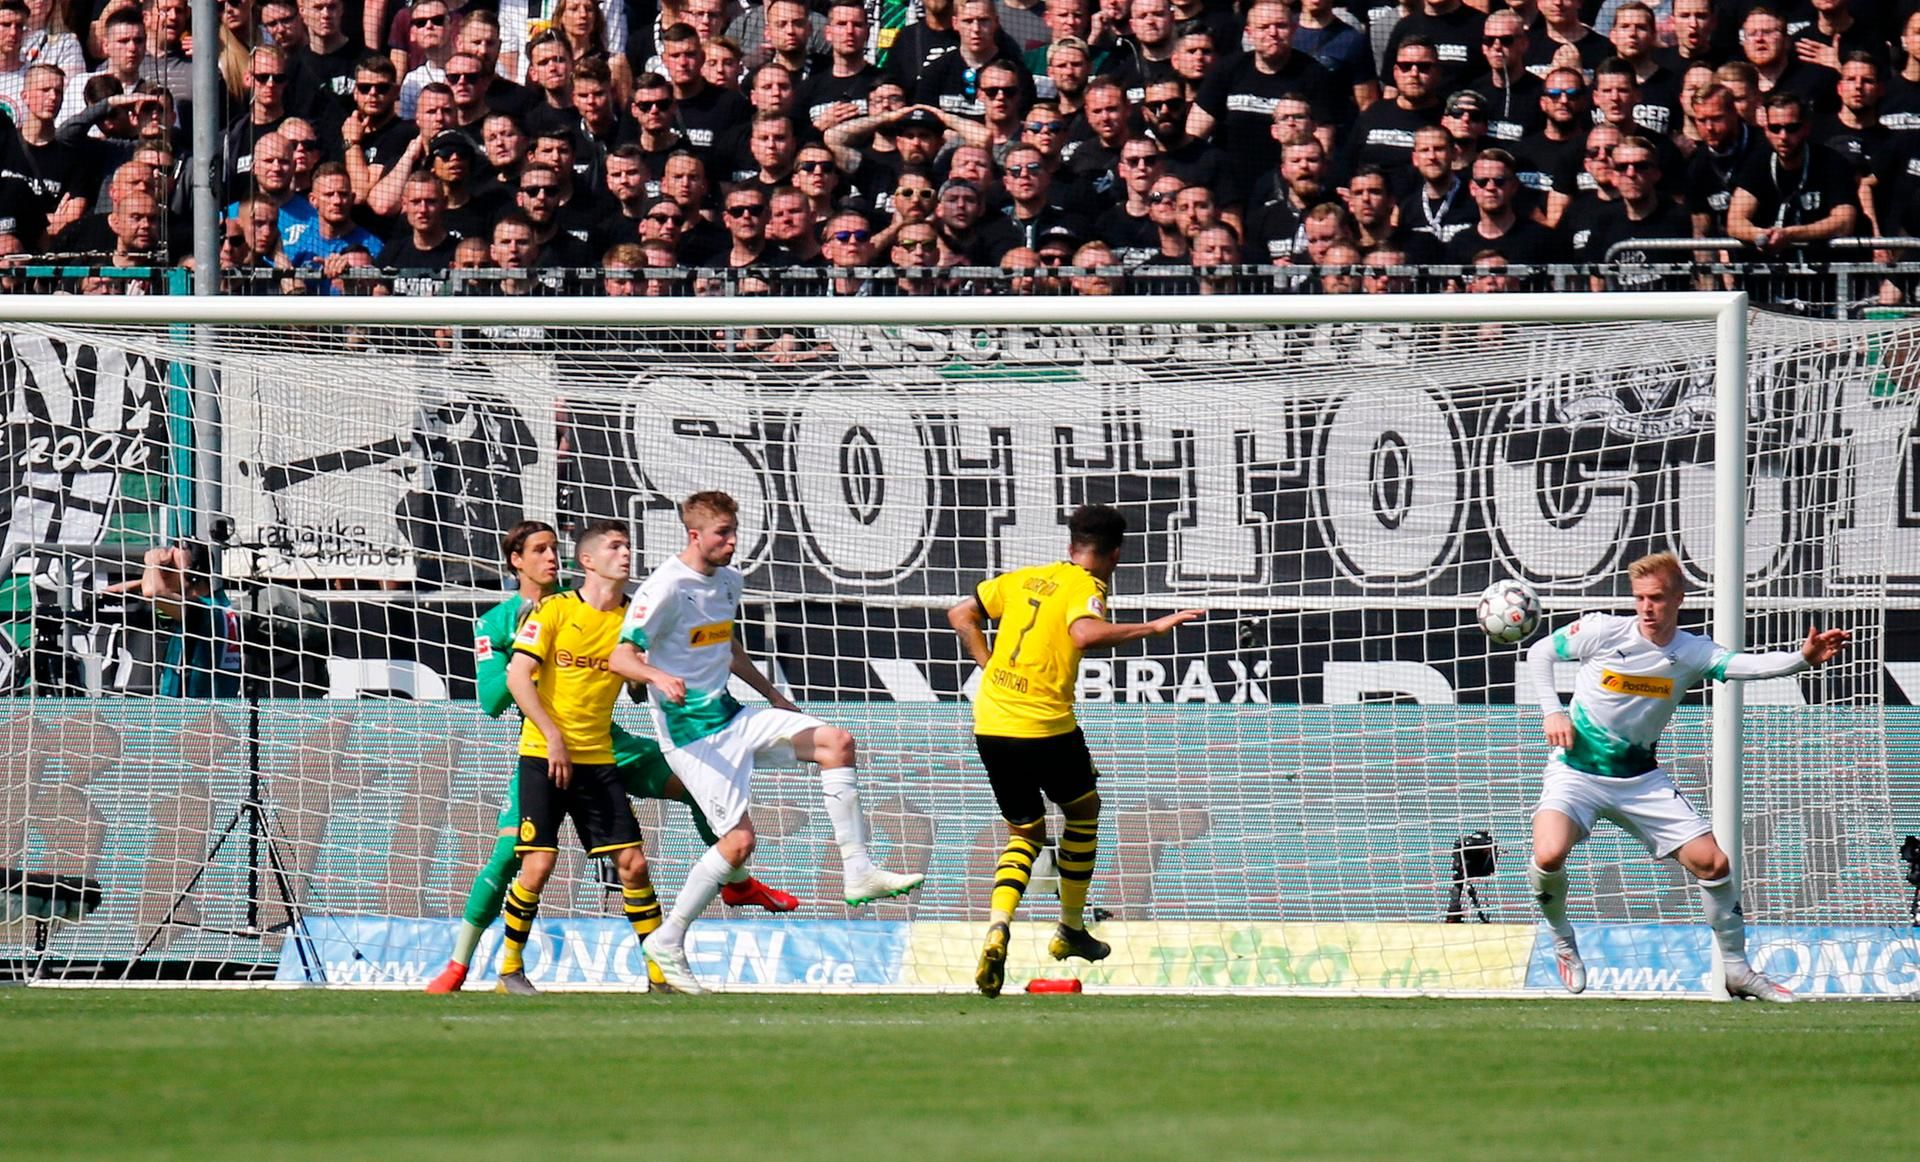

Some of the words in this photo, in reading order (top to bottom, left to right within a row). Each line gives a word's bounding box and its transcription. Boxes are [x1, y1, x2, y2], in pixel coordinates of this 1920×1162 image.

[18, 433, 151, 472] 2006
[1009, 597, 1041, 667] 7
[991, 668, 1029, 694] SANCHO
[1074, 660, 1271, 702] BRAX
[1622, 680, 1671, 694] Postbank
